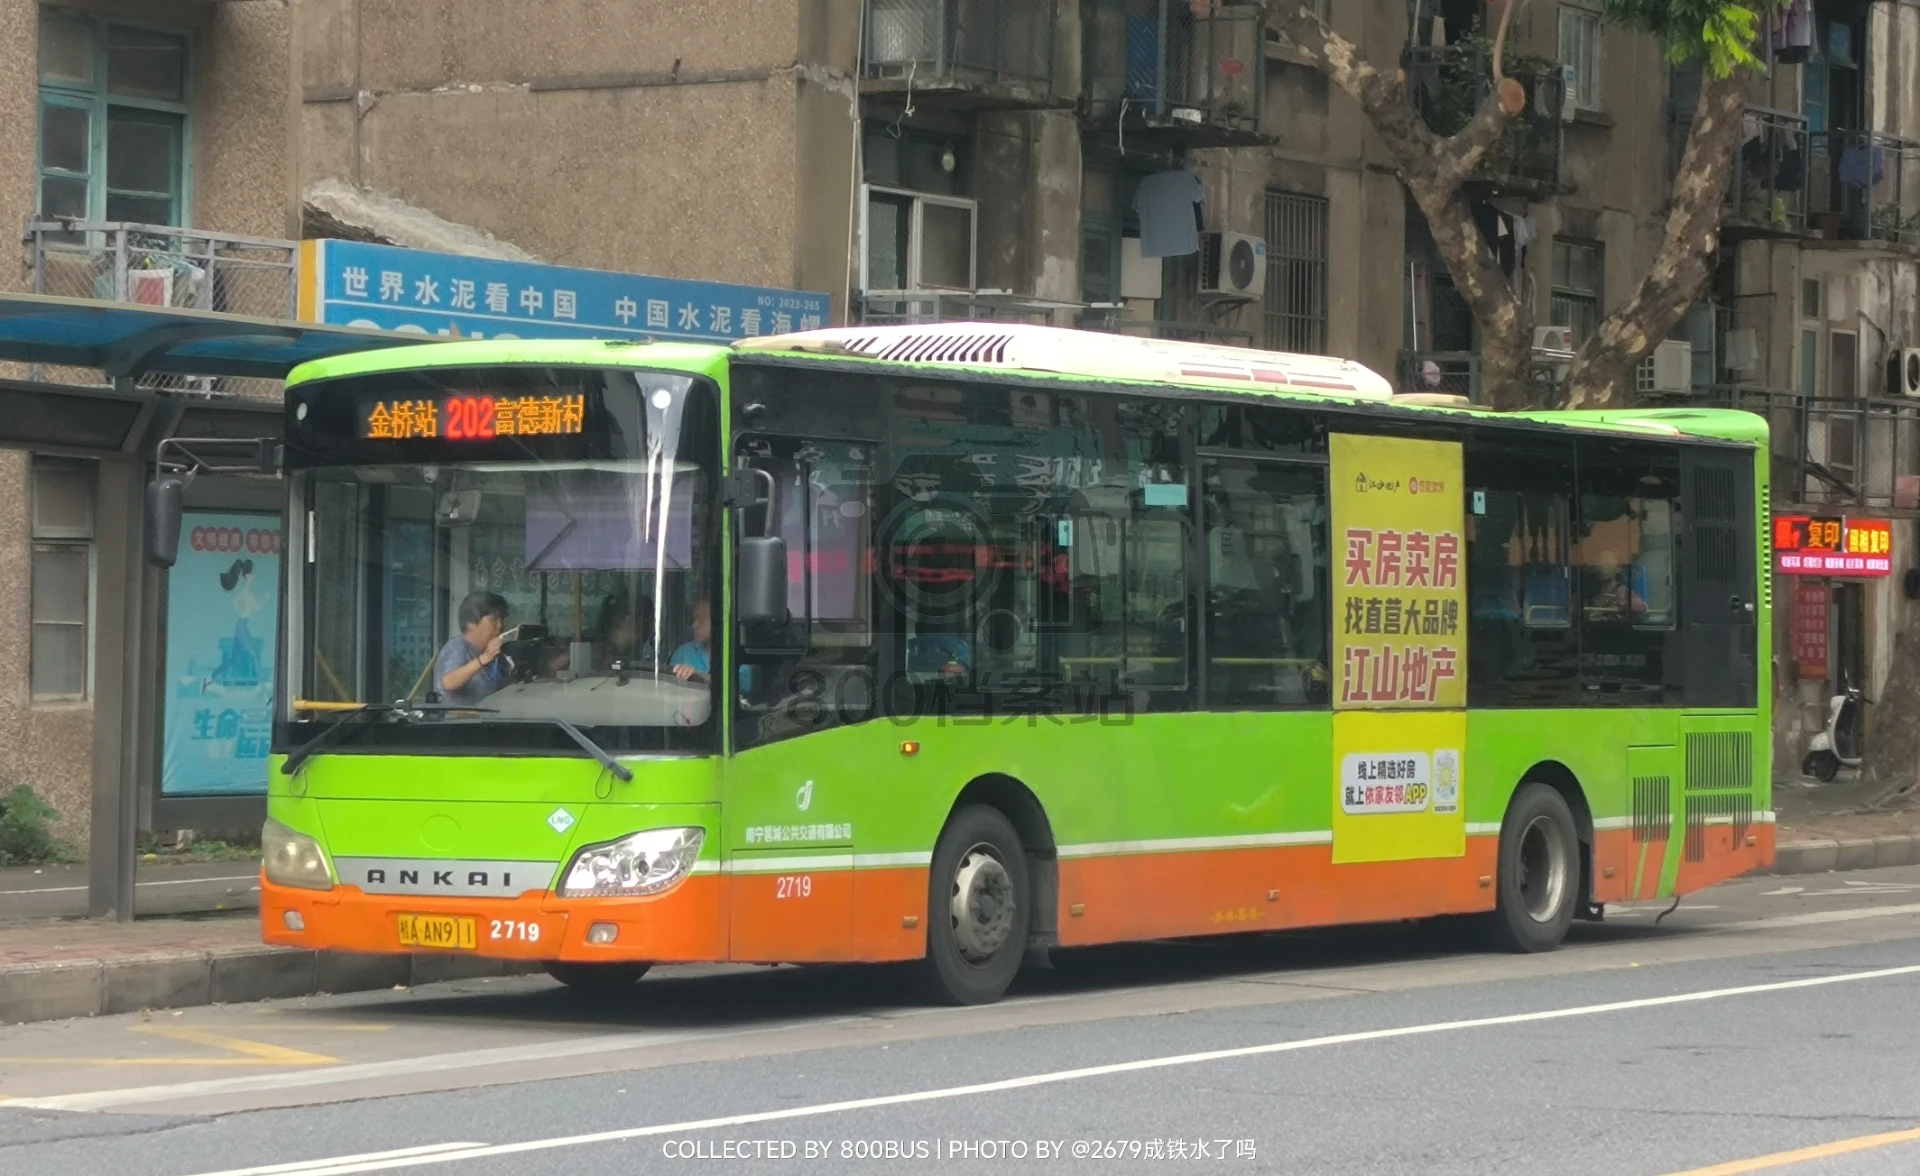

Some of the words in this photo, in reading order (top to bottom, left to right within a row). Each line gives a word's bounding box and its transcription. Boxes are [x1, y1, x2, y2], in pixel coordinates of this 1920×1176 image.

[343, 266, 577, 320] 世界水泥看中国
[779, 297, 820, 311] 2023-265
[367, 400, 438, 438] 金桥站
[447, 397, 495, 439] 202
[495, 395, 585, 435] 富德新村
[1808, 520, 1840, 549] 复印
[1345, 529, 1459, 588] 买房卖房
[1344, 596, 1459, 636] 找直营大品牌
[1341, 646, 1457, 702] 江山地产
[1357, 759, 1416, 781] 线上精选好房
[552, 816, 570, 825] LNG
[367, 869, 511, 887] ANKAI
[777, 876, 811, 898] 2719
[490, 919, 540, 942] 2719
